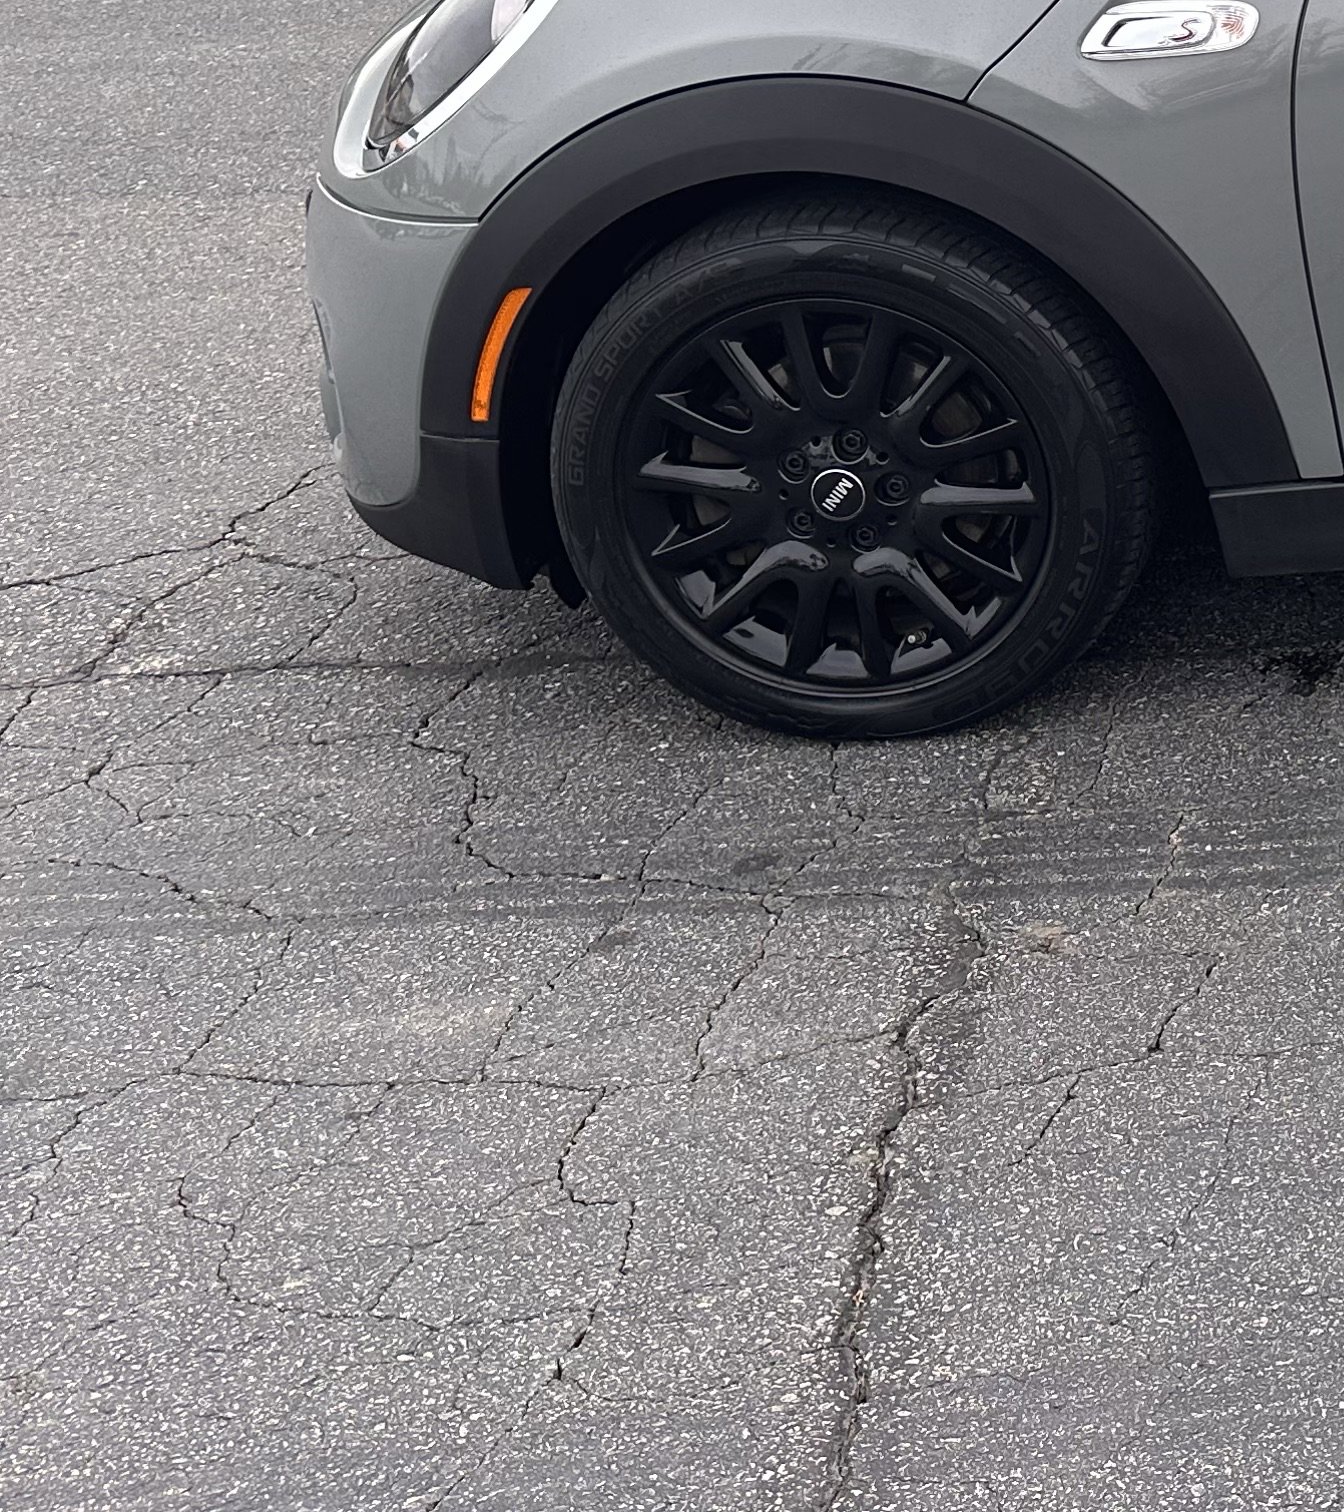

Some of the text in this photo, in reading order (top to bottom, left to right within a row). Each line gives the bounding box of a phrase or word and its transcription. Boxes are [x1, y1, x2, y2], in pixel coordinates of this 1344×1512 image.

[566, 383, 603, 488] GRAND
[594, 305, 664, 384] SPORT
[821, 477, 854, 512] MINI
